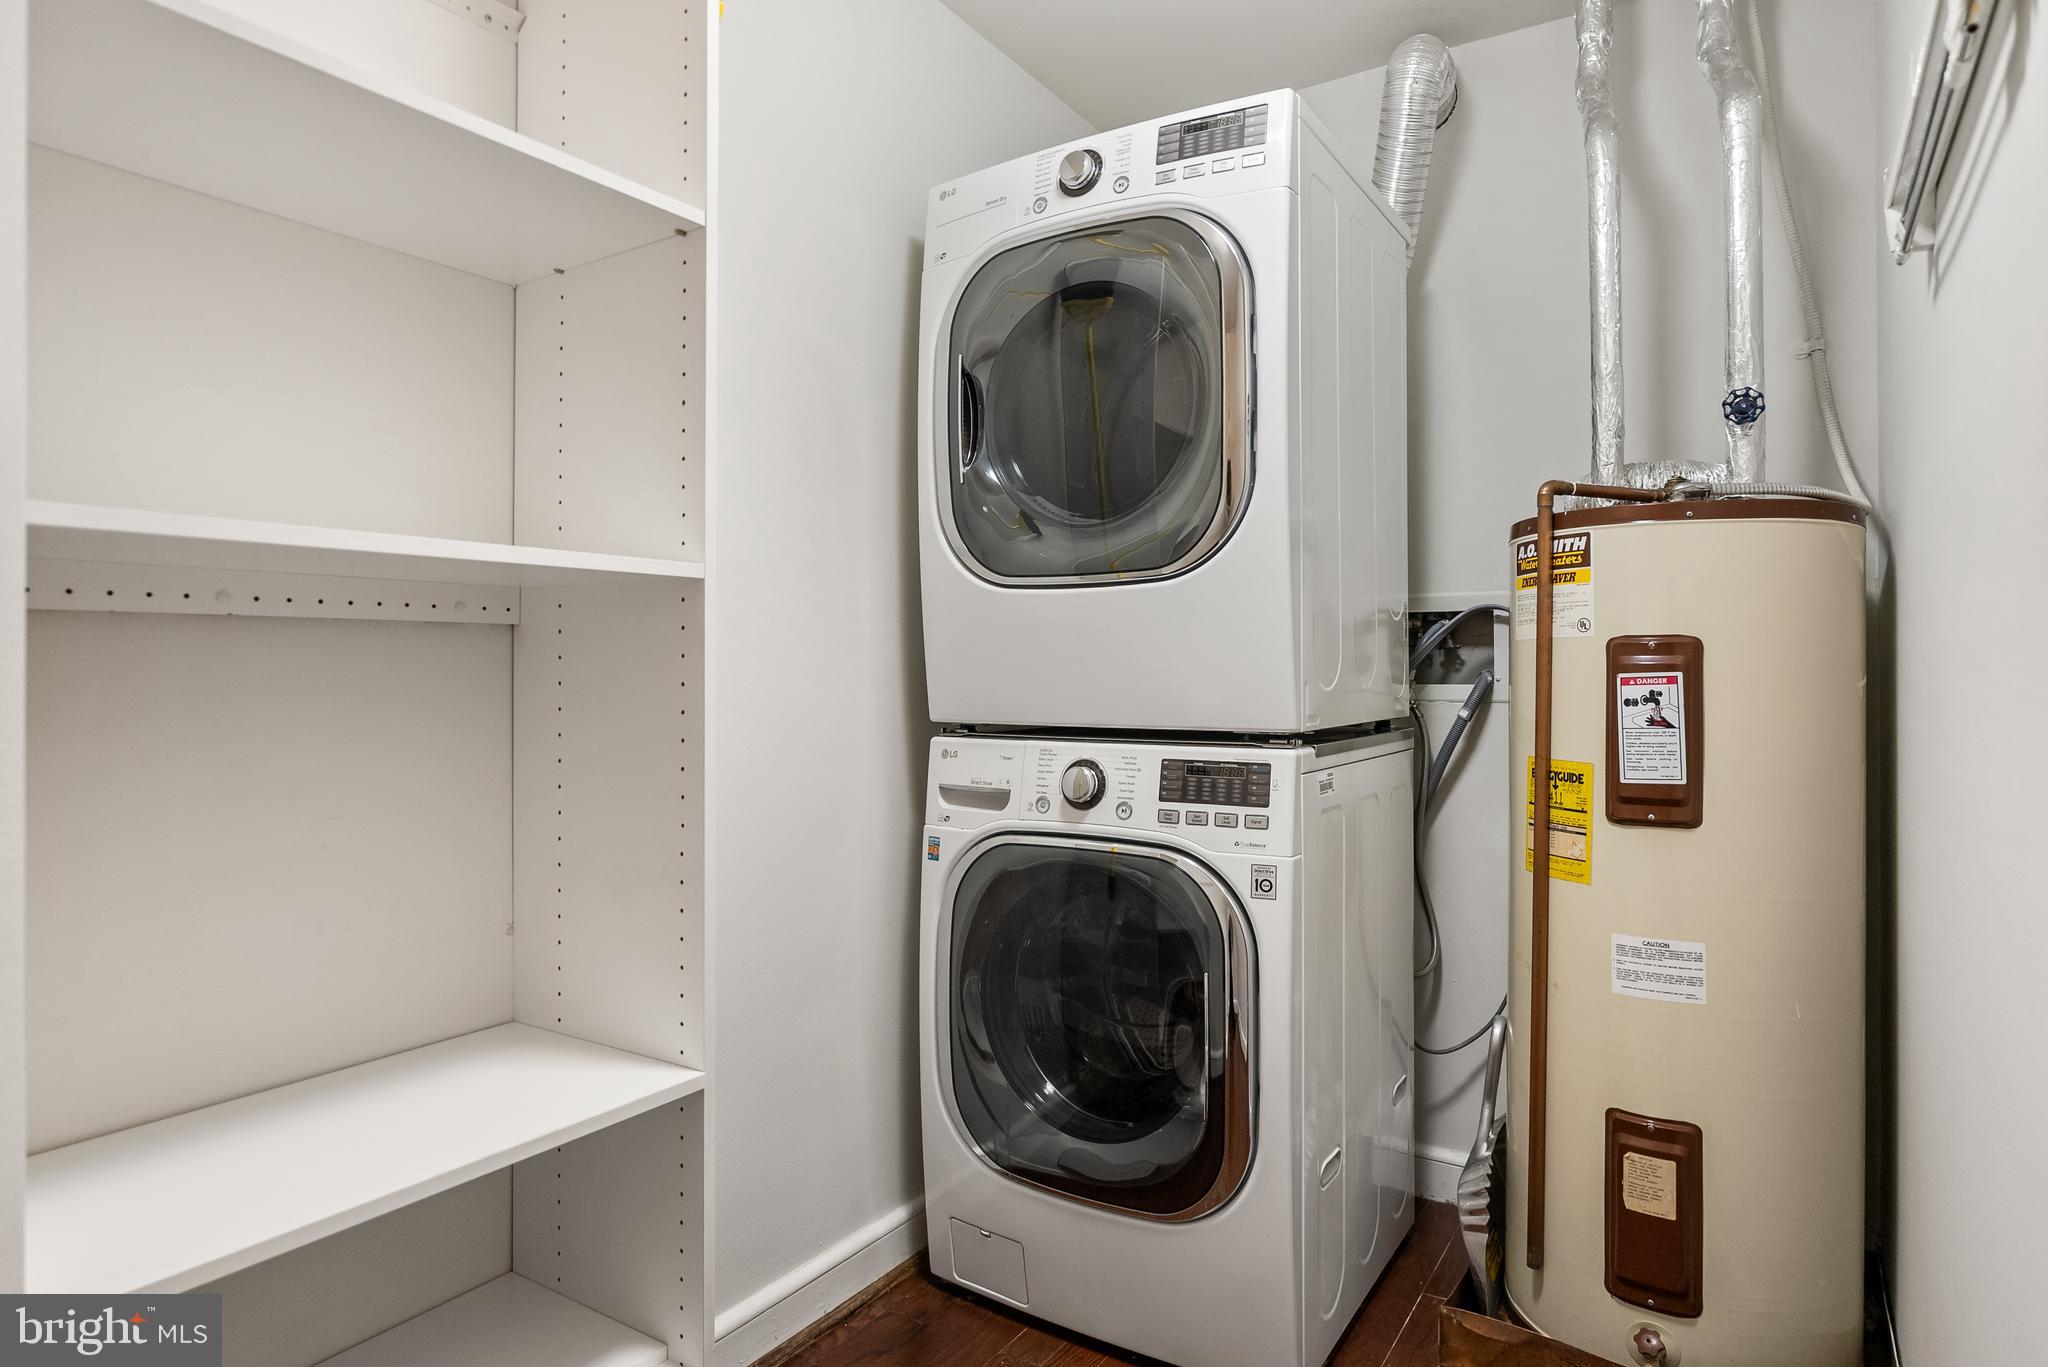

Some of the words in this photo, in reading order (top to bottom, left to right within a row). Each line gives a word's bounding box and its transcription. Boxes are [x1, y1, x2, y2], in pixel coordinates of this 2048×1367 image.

[948, 188, 957, 197] LG
[1518, 543, 1537, 560] A.O.
[1637, 677, 1667, 685] DANGER
[949, 750, 958, 759] LG
[1255, 878, 1273, 893] 10
[1642, 940, 1670, 949] CAUTION
